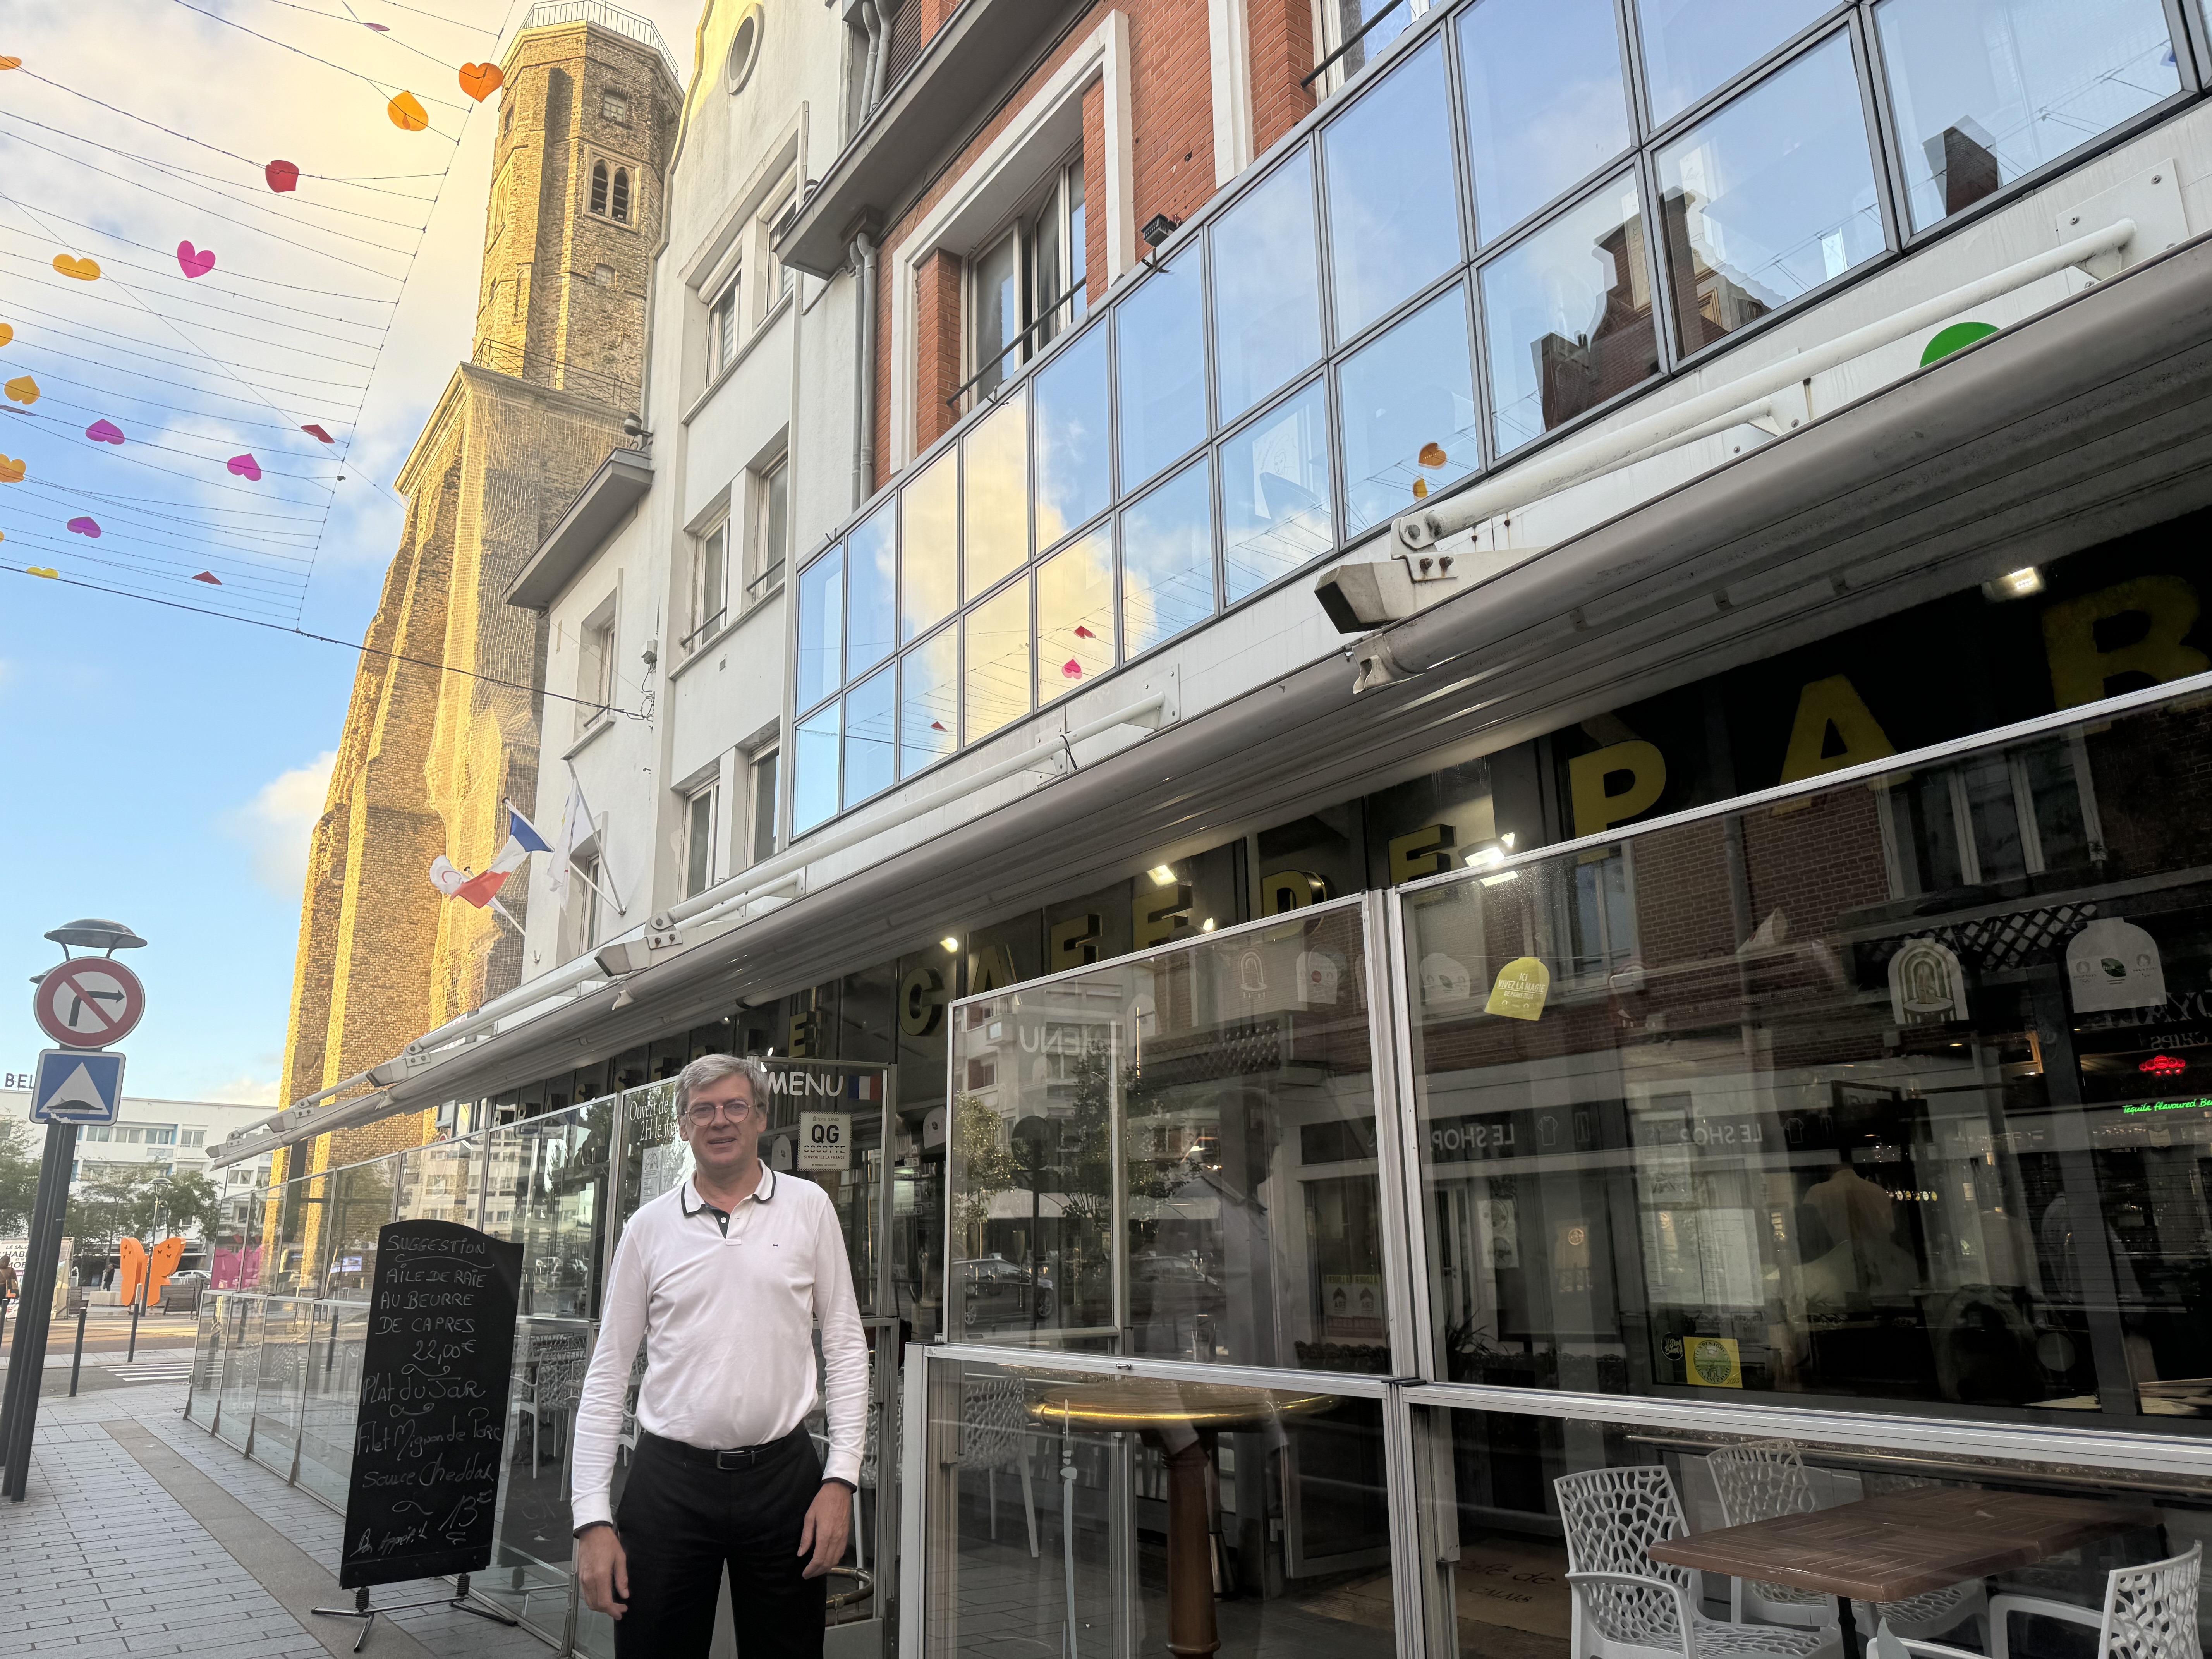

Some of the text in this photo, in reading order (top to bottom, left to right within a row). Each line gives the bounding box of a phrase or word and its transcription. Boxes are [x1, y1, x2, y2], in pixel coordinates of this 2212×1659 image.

[1498, 979, 1545, 992] VIVEZ LA MAGIE
[1519, 973, 1528, 981] ICI
[768, 1071, 843, 1097] MENU
[630, 1093, 668, 1121] Ouvert de
[2122, 1103, 2152, 1115] Tequila
[2154, 1099, 2197, 1111] flavoured
[655, 1117, 661, 1139] le
[664, 1120, 678, 1137] wee
[812, 1124, 839, 1144] QG
[386, 1235, 486, 1254] SUGGESTION
[386, 1263, 424, 1283] AILE
[426, 1271, 450, 1282] DE
[381, 1291, 474, 1309] AU BEURRE
[375, 1316, 475, 1334] DE CAPRES
[400, 1377, 425, 1400] du
[447, 1415, 465, 1441] de
